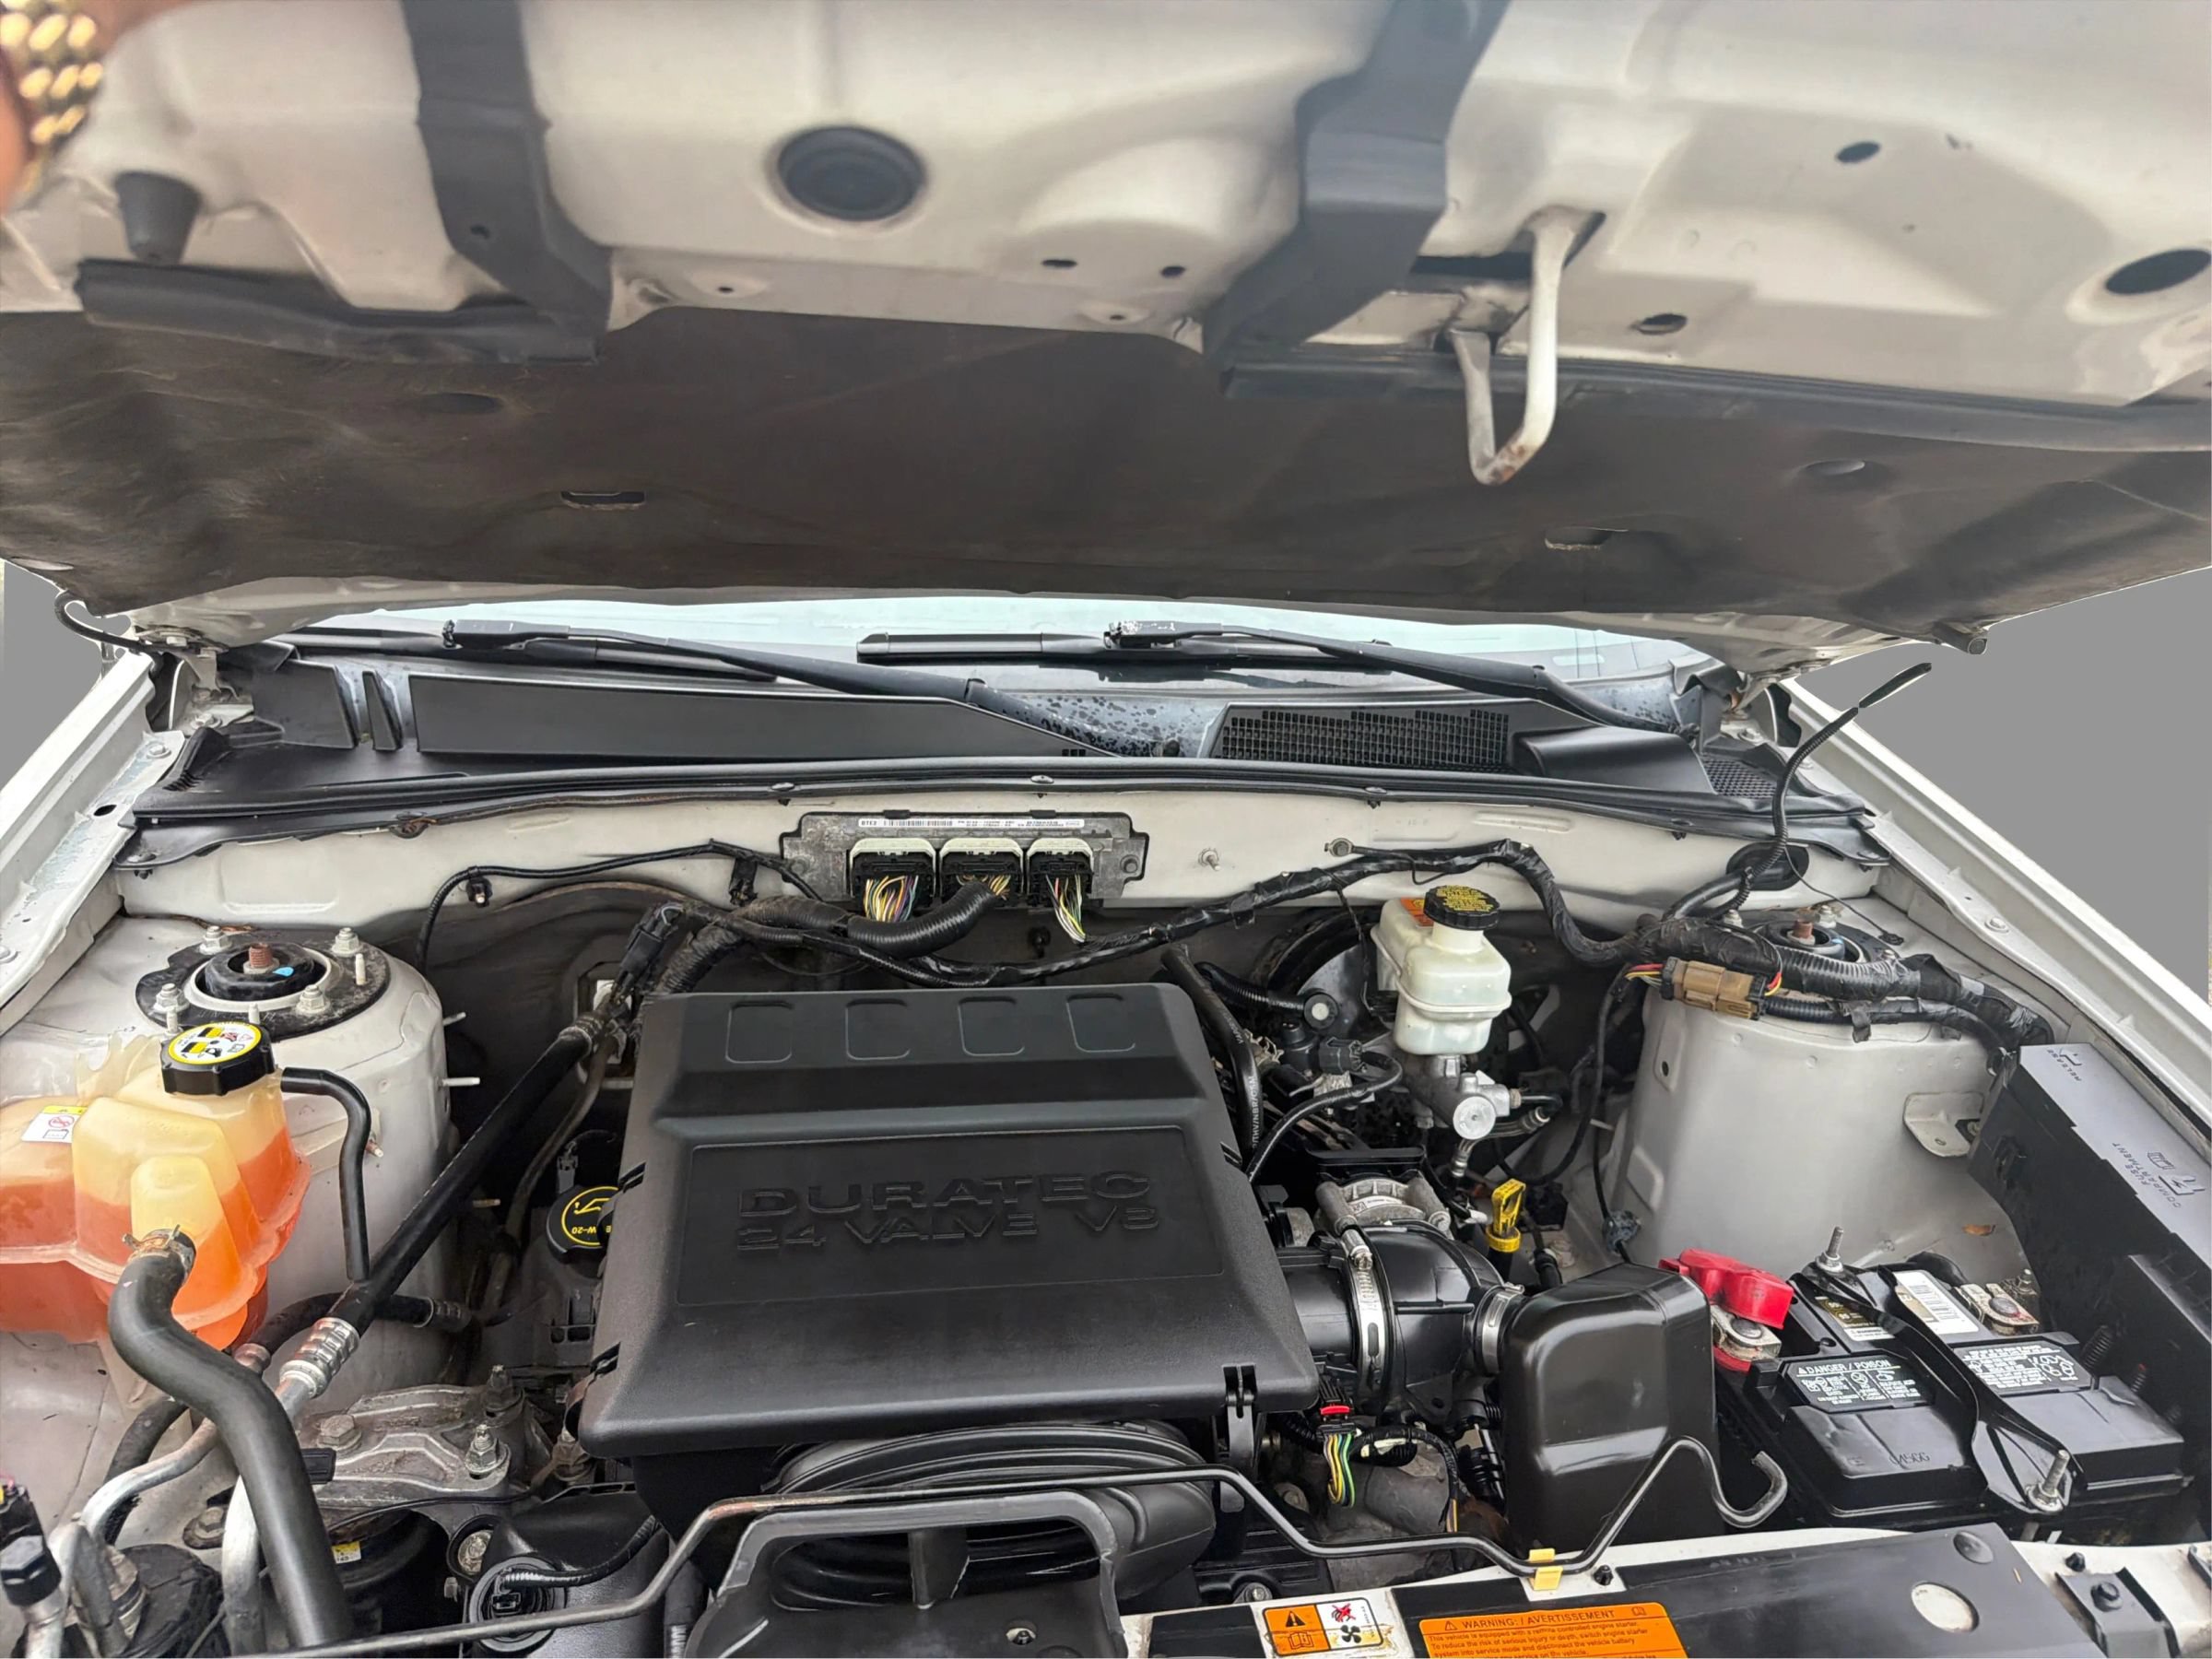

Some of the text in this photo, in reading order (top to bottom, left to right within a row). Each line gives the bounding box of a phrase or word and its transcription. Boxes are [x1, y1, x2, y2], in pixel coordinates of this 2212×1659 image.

[2047, 1049, 2082, 1081] RELEASE
[2112, 1142, 2182, 1208] COMPARTMENT
[2124, 1164, 2150, 1186] FUSE
[740, 1171, 1150, 1217] DURATEC
[736, 1222, 827, 1251] 24
[844, 1211, 1038, 1244] VALVE
[1806, 1363, 1847, 1374] DANGER
[1853, 1359, 1892, 1370] POISON
[1462, 1618, 1519, 1630] WARNING:
[1527, 1609, 1615, 1625] AVERTISSEMENT
